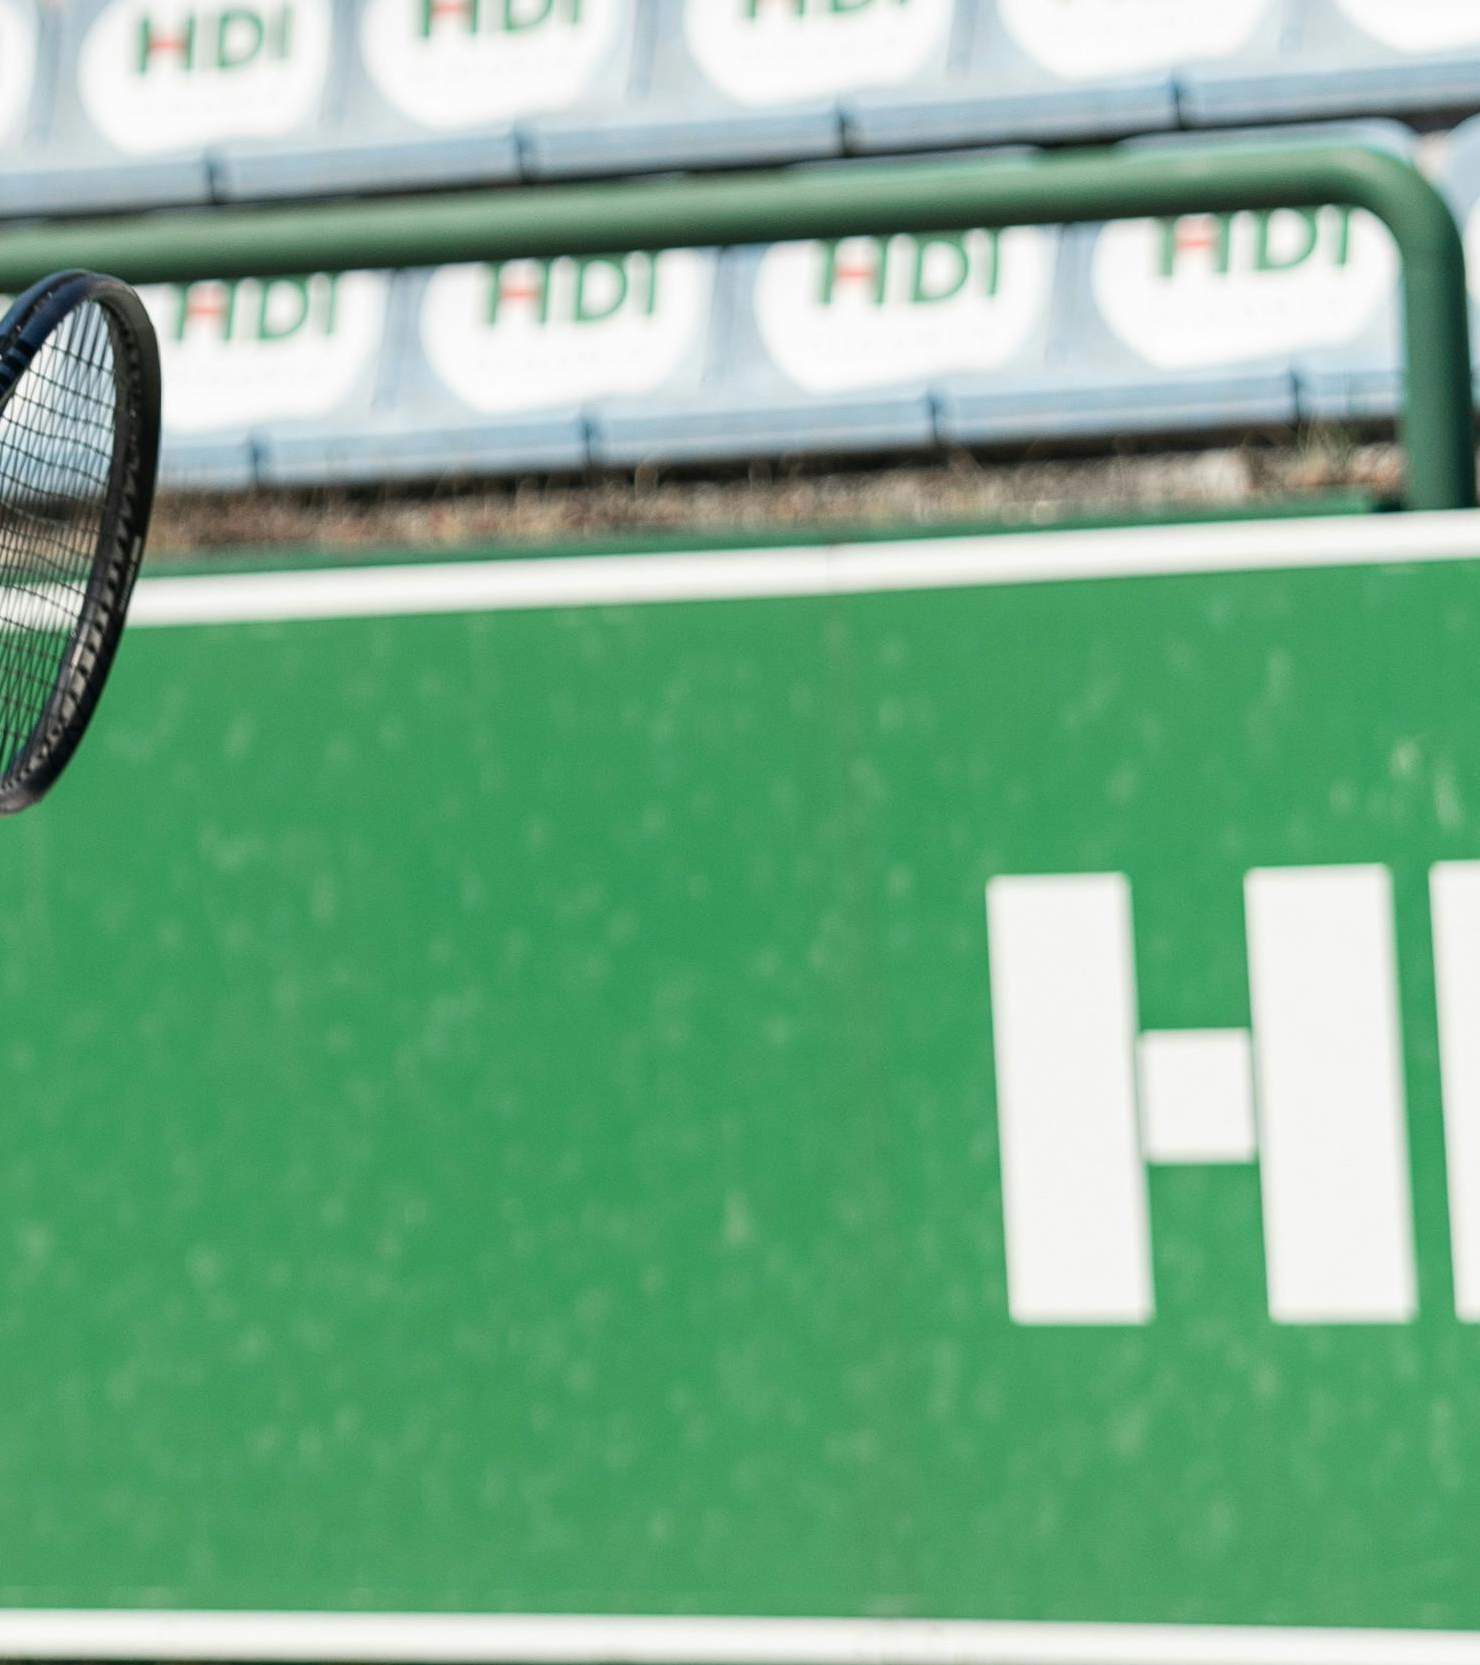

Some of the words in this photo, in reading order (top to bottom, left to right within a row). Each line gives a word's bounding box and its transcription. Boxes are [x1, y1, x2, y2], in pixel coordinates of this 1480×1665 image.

[820, 233, 1000, 306] HDI
[1156, 204, 1352, 277] HDI
[177, 271, 338, 342] HDI
[485, 252, 658, 326] HDI
